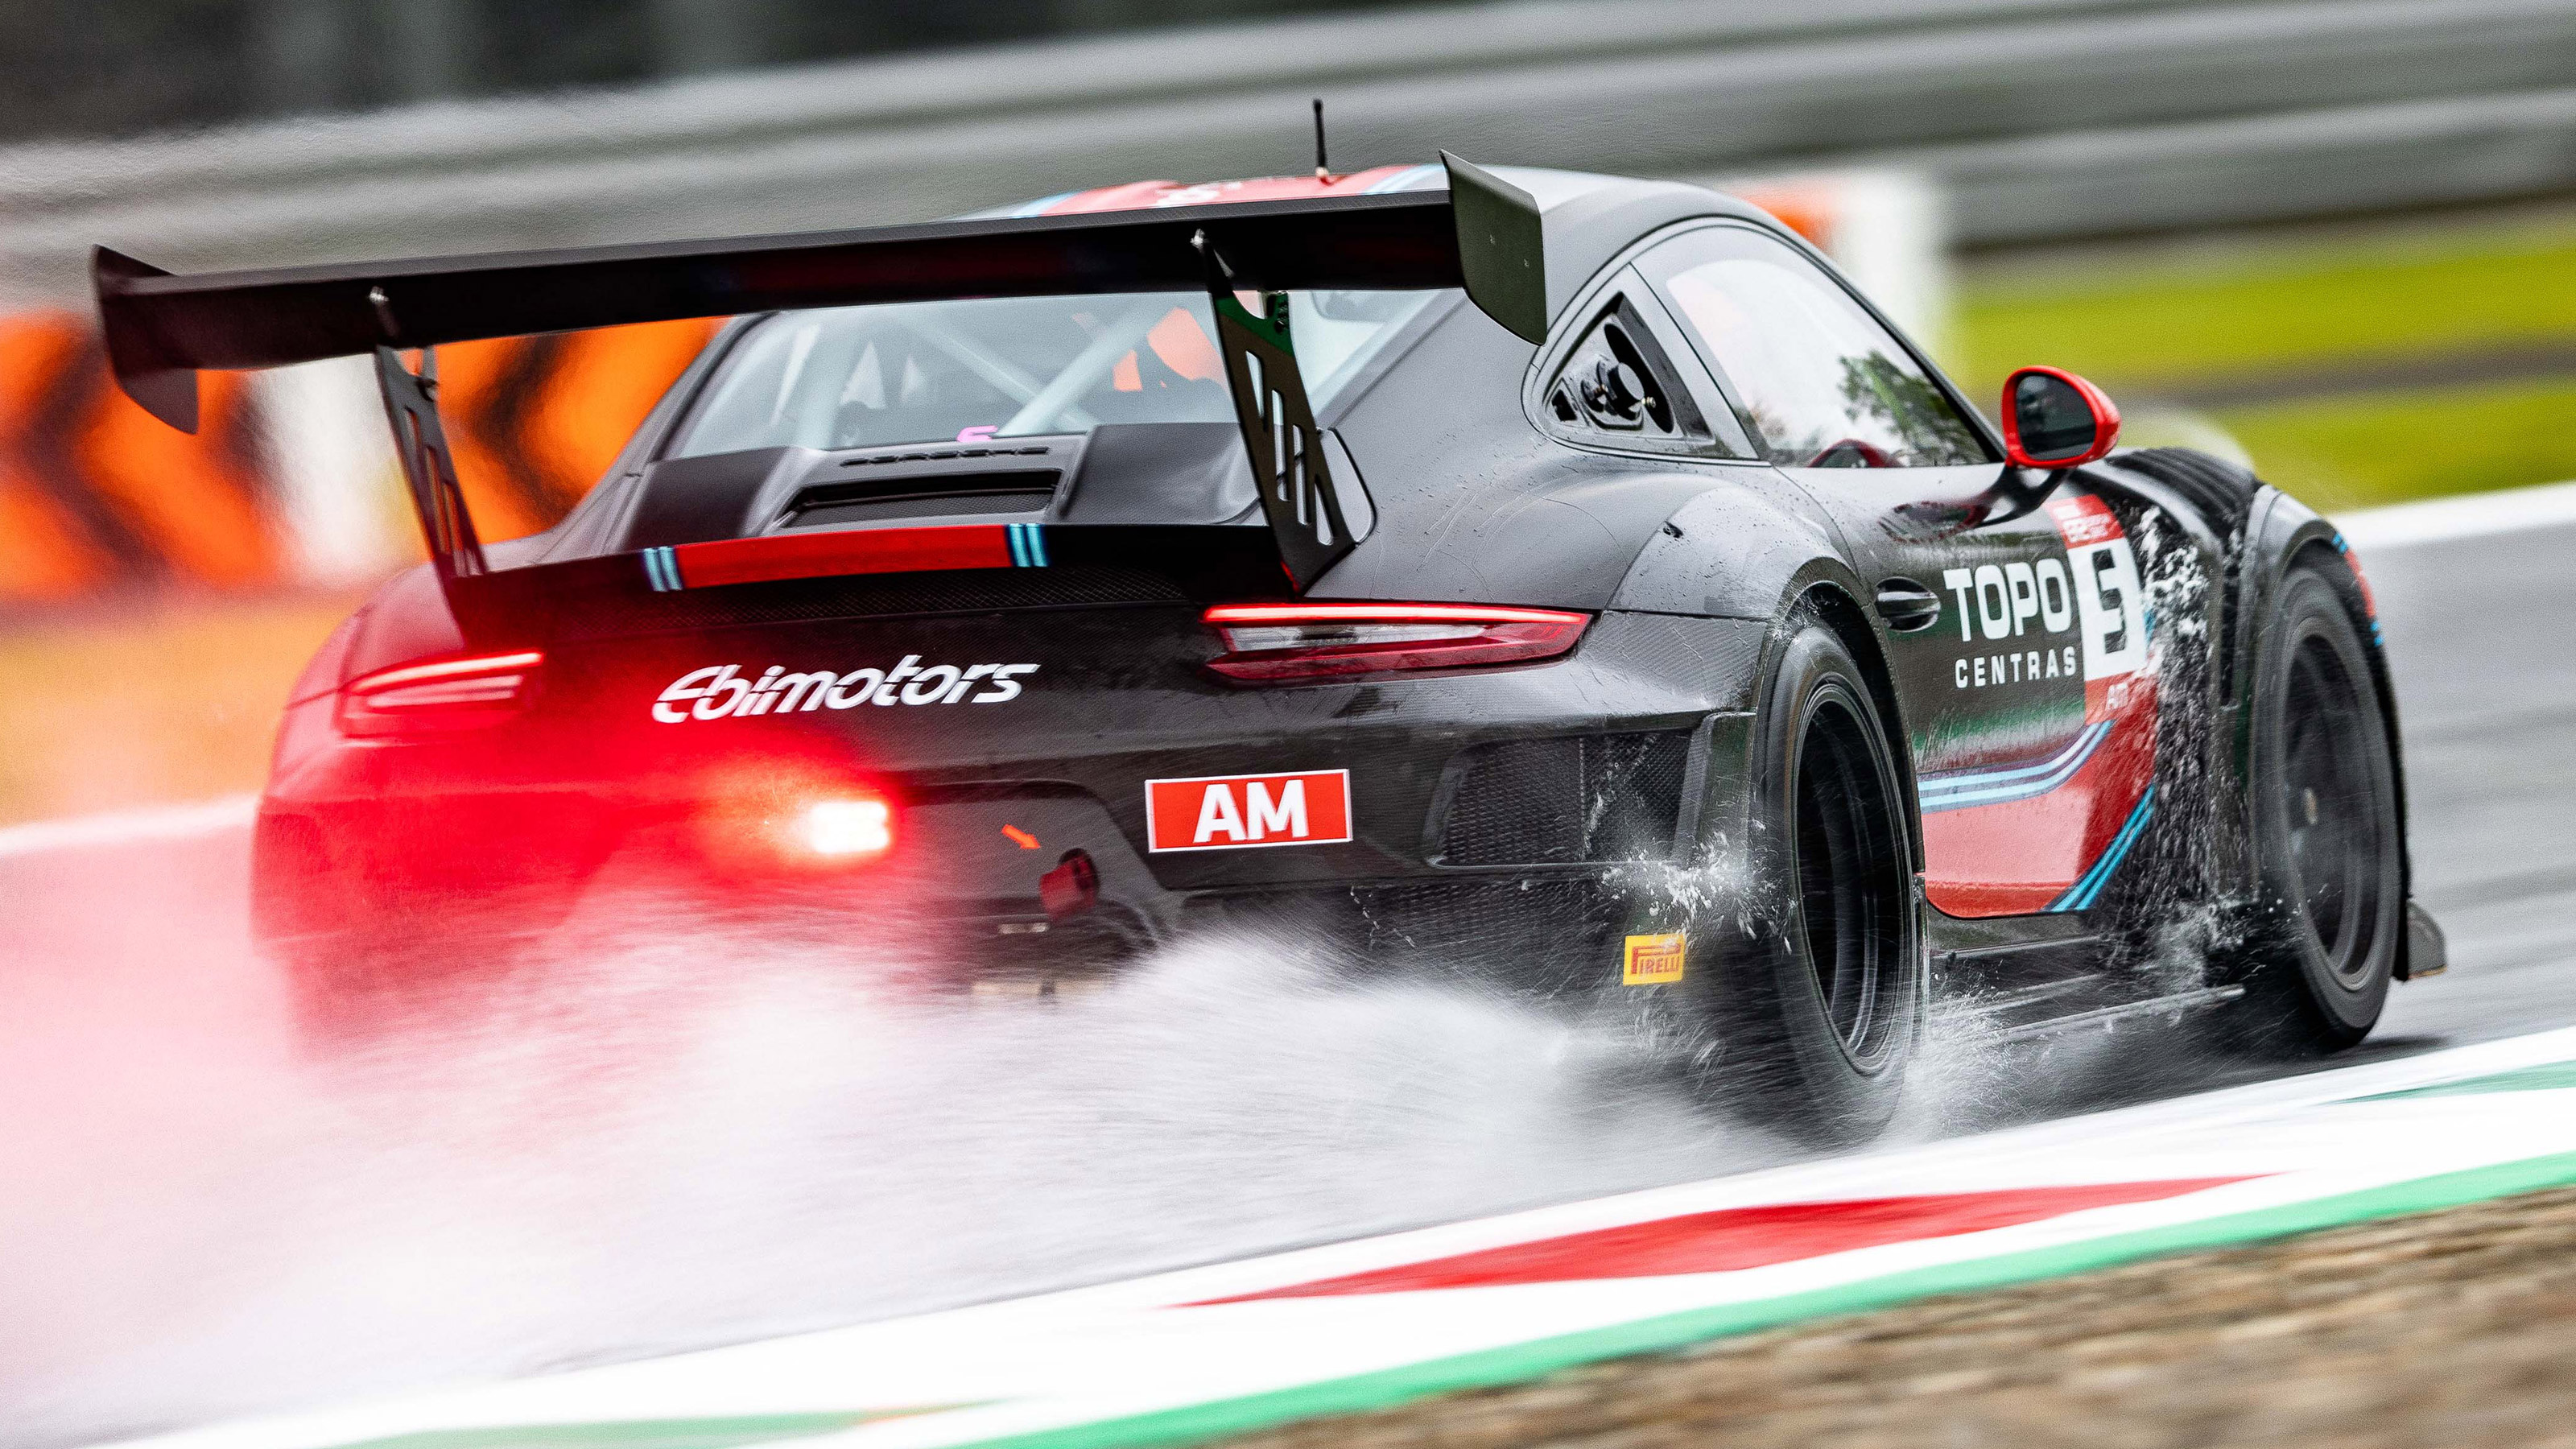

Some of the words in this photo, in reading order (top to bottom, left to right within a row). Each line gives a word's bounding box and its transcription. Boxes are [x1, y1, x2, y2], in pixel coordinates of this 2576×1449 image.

[1942, 558, 2072, 642] TOPO
[2091, 547, 2127, 654] 5
[1955, 646, 2077, 689] CENTRAS
[1192, 779, 1310, 844] AM
[1630, 943, 1682, 975] PIRELLI
